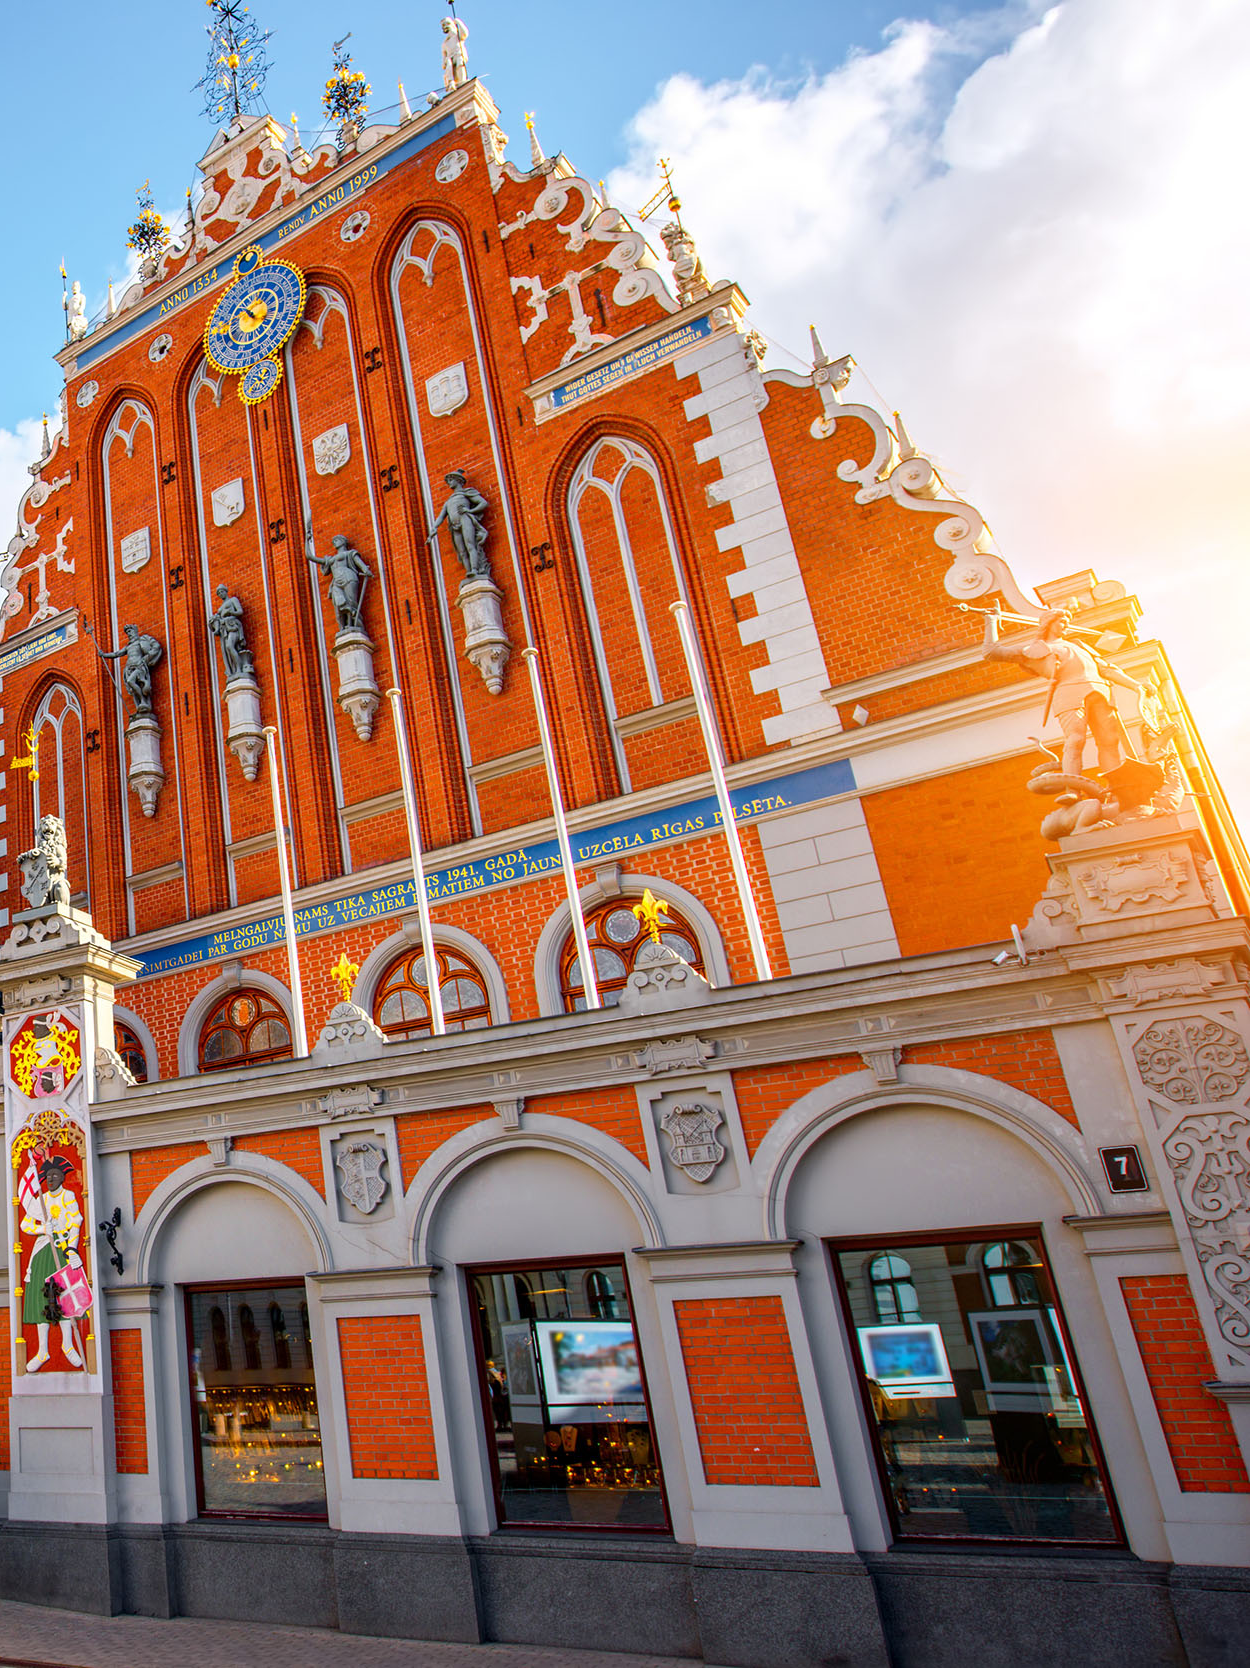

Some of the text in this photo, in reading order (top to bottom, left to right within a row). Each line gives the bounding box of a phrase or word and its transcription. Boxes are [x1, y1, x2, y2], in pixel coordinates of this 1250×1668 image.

[278, 165, 378, 239] RENOV ANNO 1999
[159, 268, 218, 316] ANNO 1334
[565, 378, 586, 393] WIDER
[586, 366, 609, 382] GESETZ
[578, 379, 602, 395] GOTTES
[602, 369, 624, 383] SEGEN
[656, 330, 703, 357] VERWANDELN
[208, 944, 228, 958] PAR
[233, 933, 268, 950] GODU
[274, 921, 310, 940] NMU
[318, 915, 336, 928] UZ
[342, 896, 406, 921] VECAJIEM
[412, 874, 485, 903] PMATIEM
[492, 867, 515, 883] NO
[523, 854, 562, 877] JAUN
[578, 833, 644, 859] UZCĒLA
[651, 817, 705, 841] RĪGAS
[713, 794, 793, 824] PLSĒTA.
[294, 905, 329, 922] NAMS
[334, 896, 366, 912] TIKA
[372, 875, 439, 902] SAGRATS
[447, 865, 479, 881] 1941.
[485, 849, 532, 871] GADĀ.
[1114, 1156, 1128, 1175] 7
